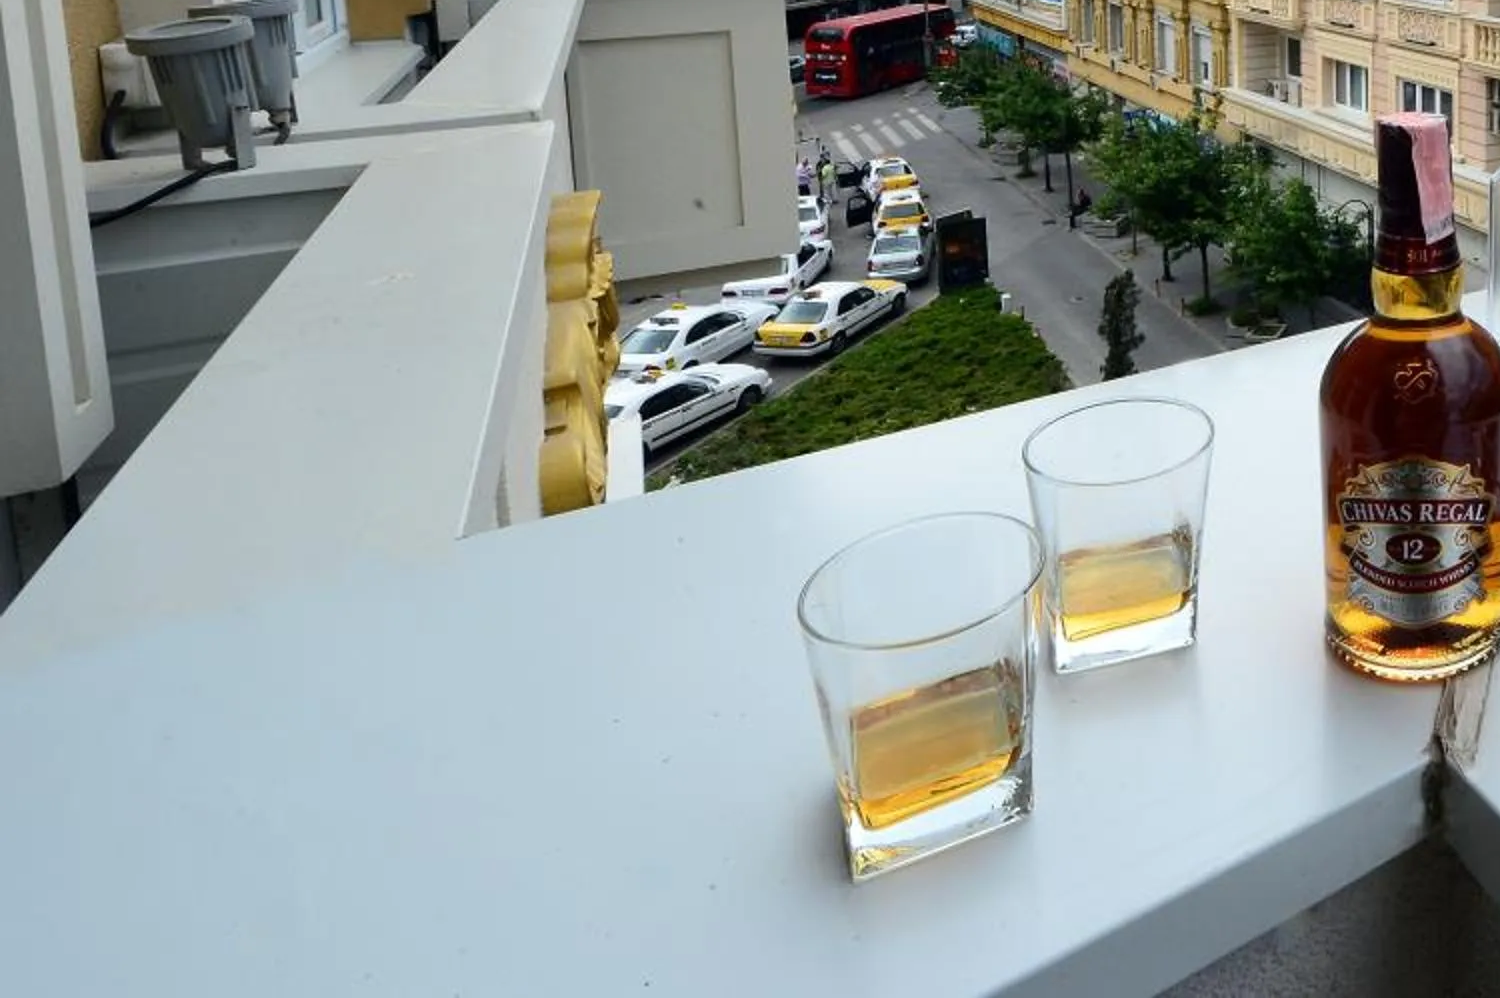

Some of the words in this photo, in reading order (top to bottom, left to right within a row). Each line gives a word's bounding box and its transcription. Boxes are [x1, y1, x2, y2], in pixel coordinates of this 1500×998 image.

[1343, 502, 1412, 522] CHIVAS
[1419, 503, 1485, 522] REGAL
[1402, 539, 1424, 559] 12
